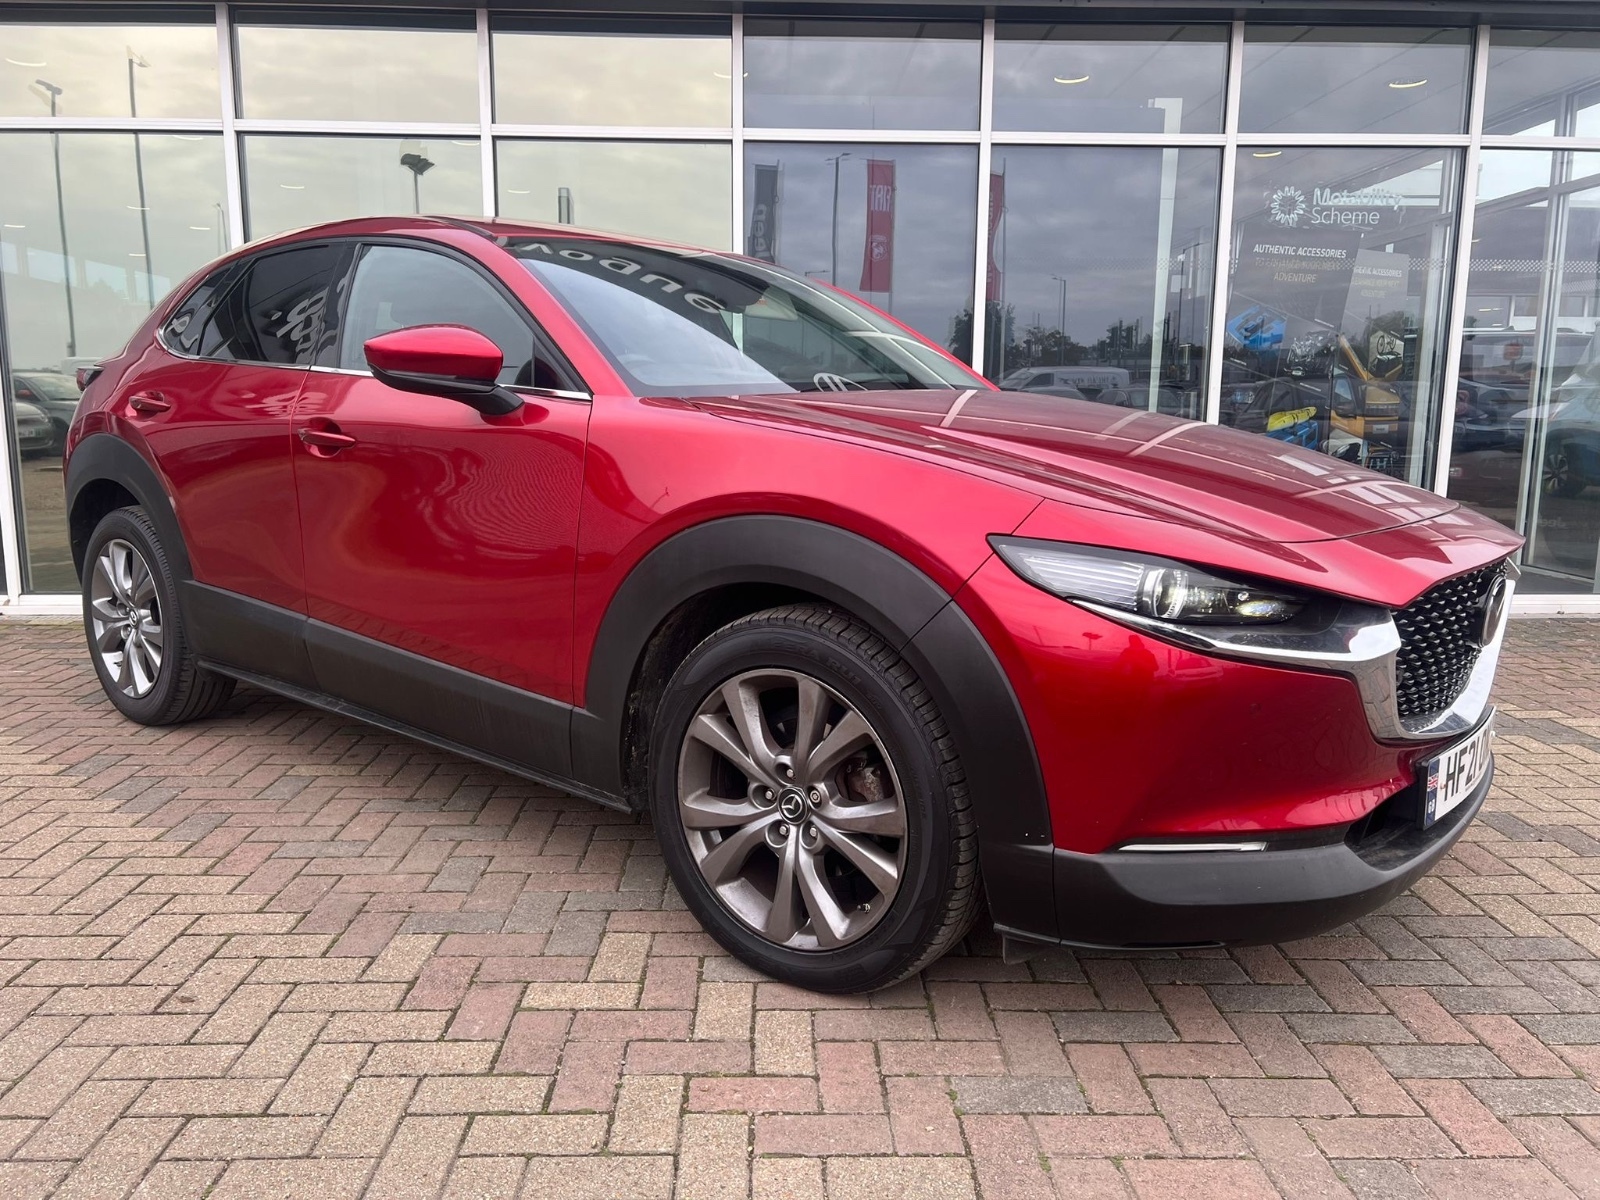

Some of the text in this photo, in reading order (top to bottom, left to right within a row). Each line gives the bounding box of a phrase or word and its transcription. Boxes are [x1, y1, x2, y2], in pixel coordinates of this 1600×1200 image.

[1313, 187, 1403, 211] Motability
[1311, 206, 1380, 225] Scheme
[1253, 243, 1347, 259] AUTHENTIC ACCESSORIES
[1273, 272, 1318, 283] ADVENTURE
[1445, 736, 1480, 801] HF21
